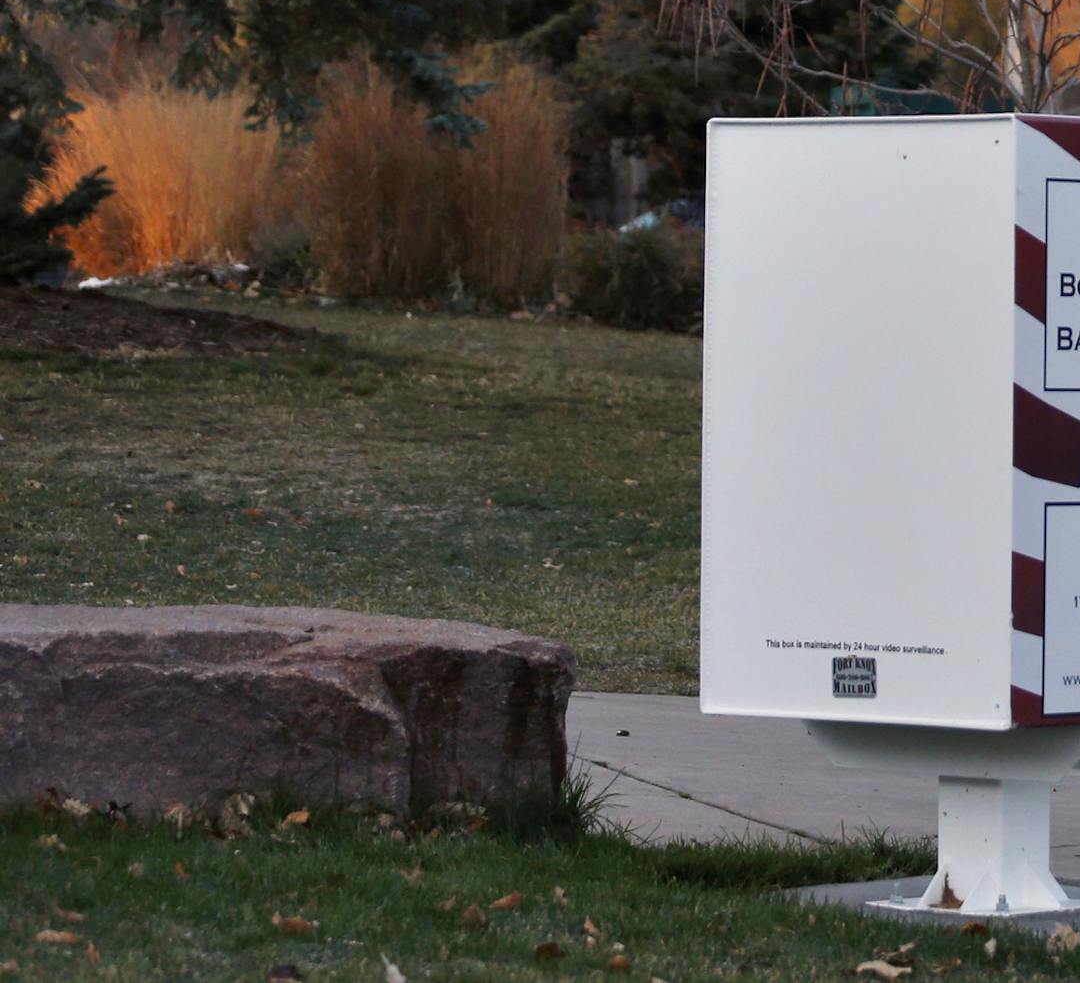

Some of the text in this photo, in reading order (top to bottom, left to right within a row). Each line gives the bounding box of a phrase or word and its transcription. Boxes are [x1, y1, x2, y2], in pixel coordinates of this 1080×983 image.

[766, 639, 780, 648] This
[782, 640, 794, 648] box
[796, 640, 802, 648] is
[804, 641, 841, 650] maintained
[843, 642, 851, 652] by
[854, 642, 862, 650] 24
[864, 643, 880, 651] hour
[882, 644, 901, 653] video
